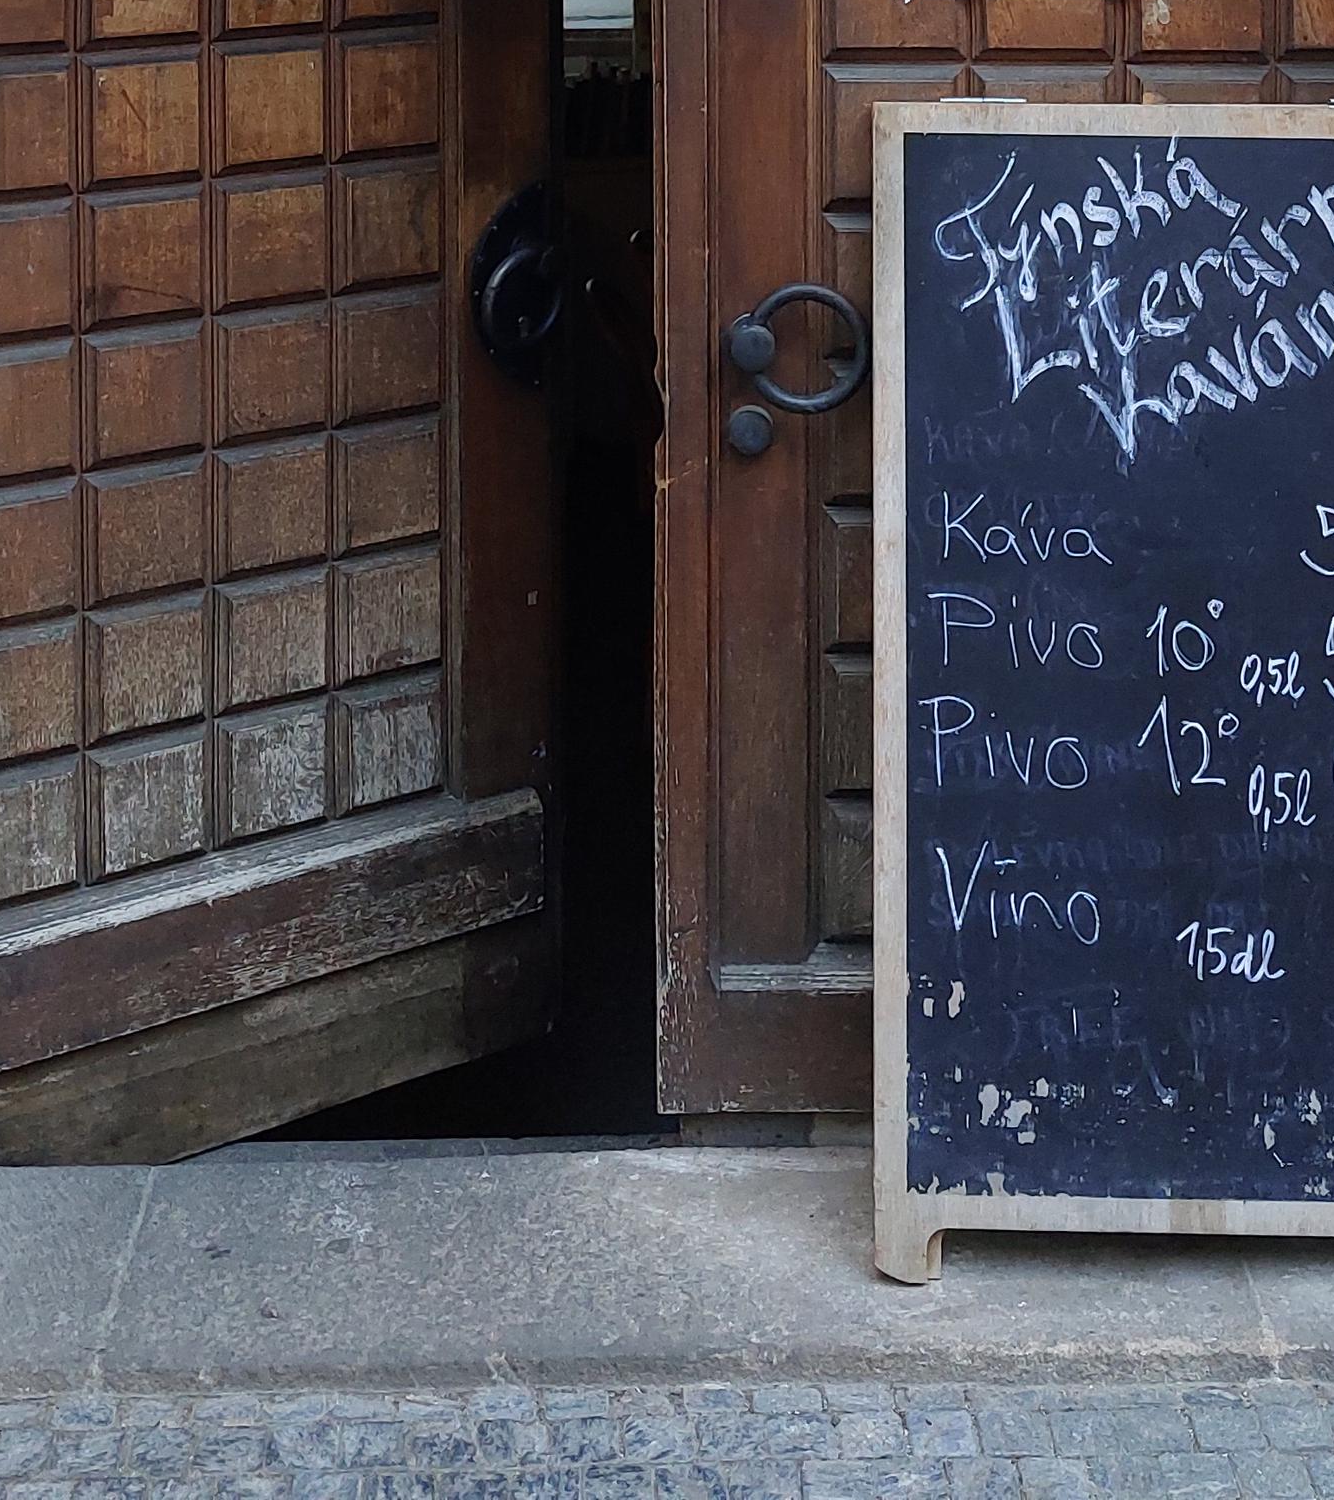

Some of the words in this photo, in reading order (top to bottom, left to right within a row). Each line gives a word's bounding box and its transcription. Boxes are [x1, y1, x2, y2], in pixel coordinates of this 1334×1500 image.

[934, 134, 1248, 311] Týnská
[942, 490, 1113, 565] Káva
[926, 592, 1105, 669] Pivo
[1145, 598, 1225, 677] 10°
[1239, 651, 1306, 706] 0,5l
[918, 695, 1089, 789] Pivo
[1138, 695, 1241, 796] 12°
[1248, 764, 1317, 834] 0,5l
[935, 840, 1101, 946] Víno
